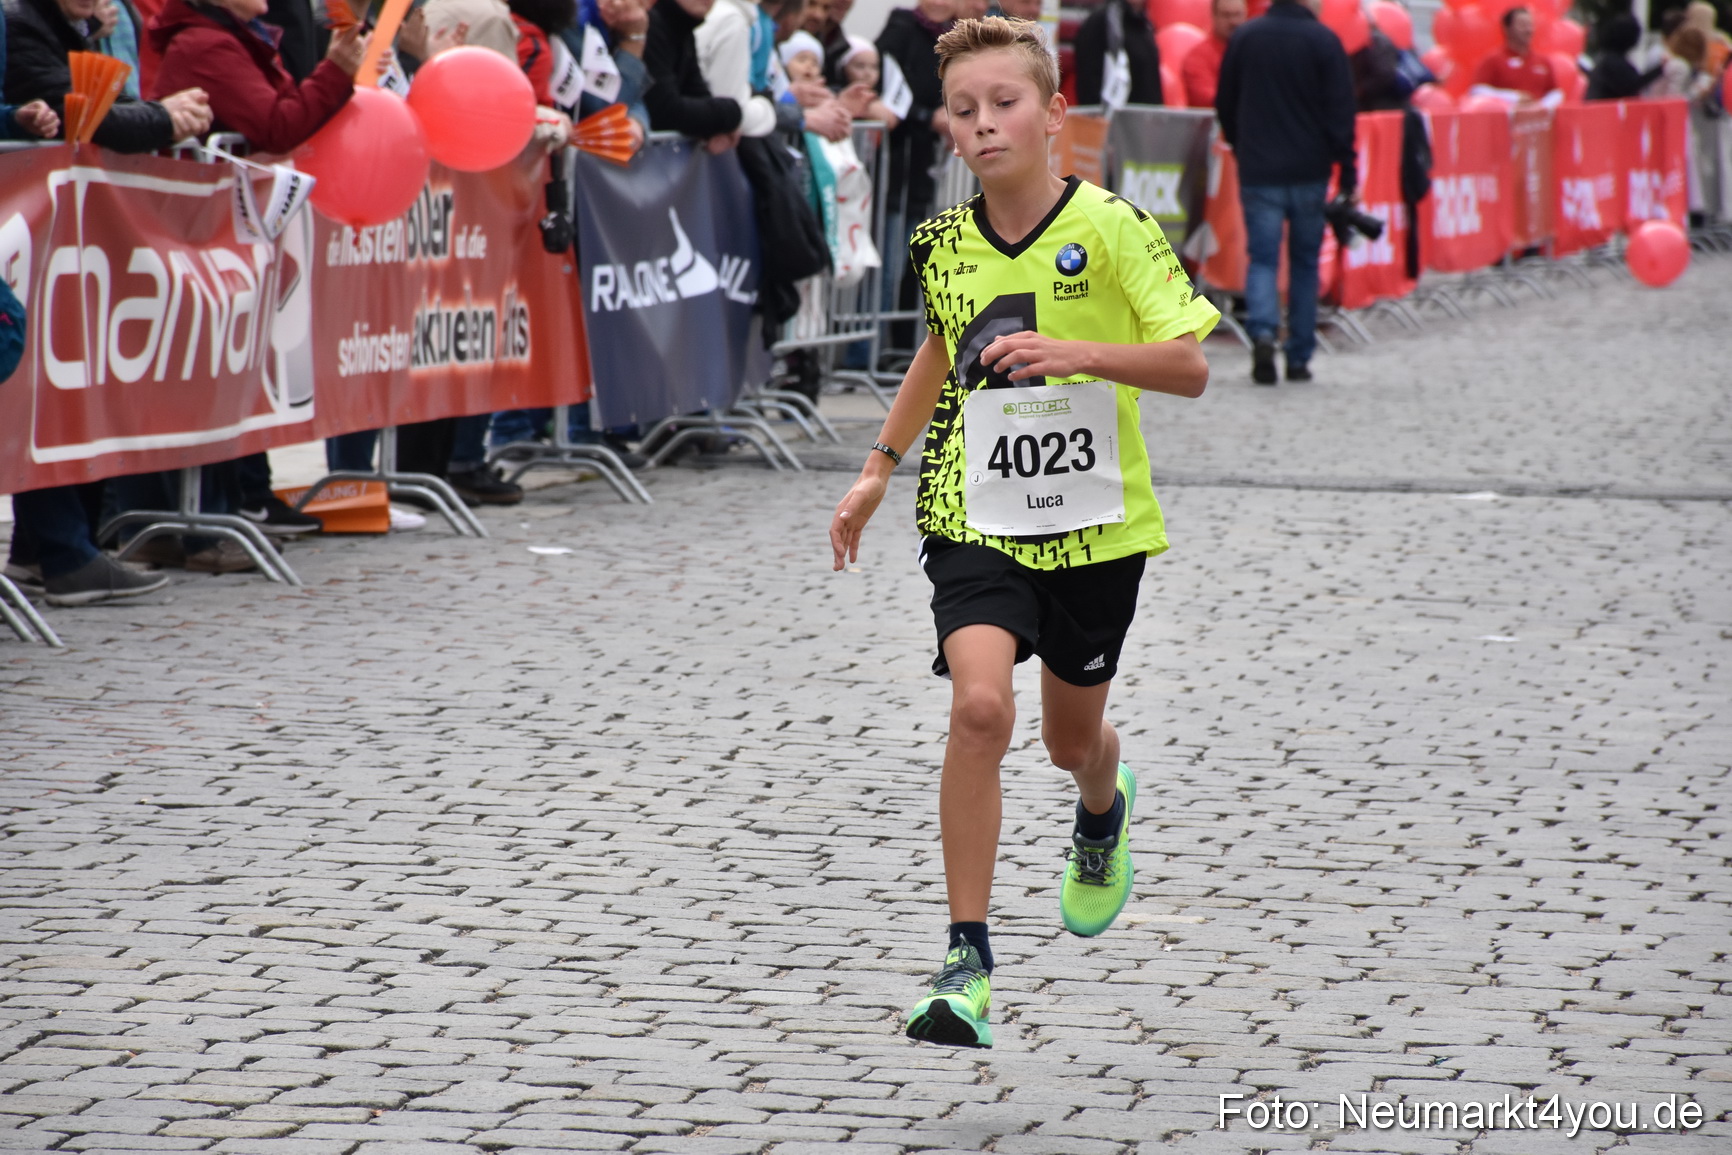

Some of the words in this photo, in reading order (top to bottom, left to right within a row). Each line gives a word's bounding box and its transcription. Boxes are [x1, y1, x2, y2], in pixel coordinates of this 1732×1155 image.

[1053, 279, 1089, 295] Partl
[1054, 292, 1089, 302] Neumarkt
[1018, 398, 1071, 415] BOCK
[987, 428, 1096, 479] 4023
[1026, 494, 1064, 509] Luca
[1084, 662, 1106, 671] adidas
